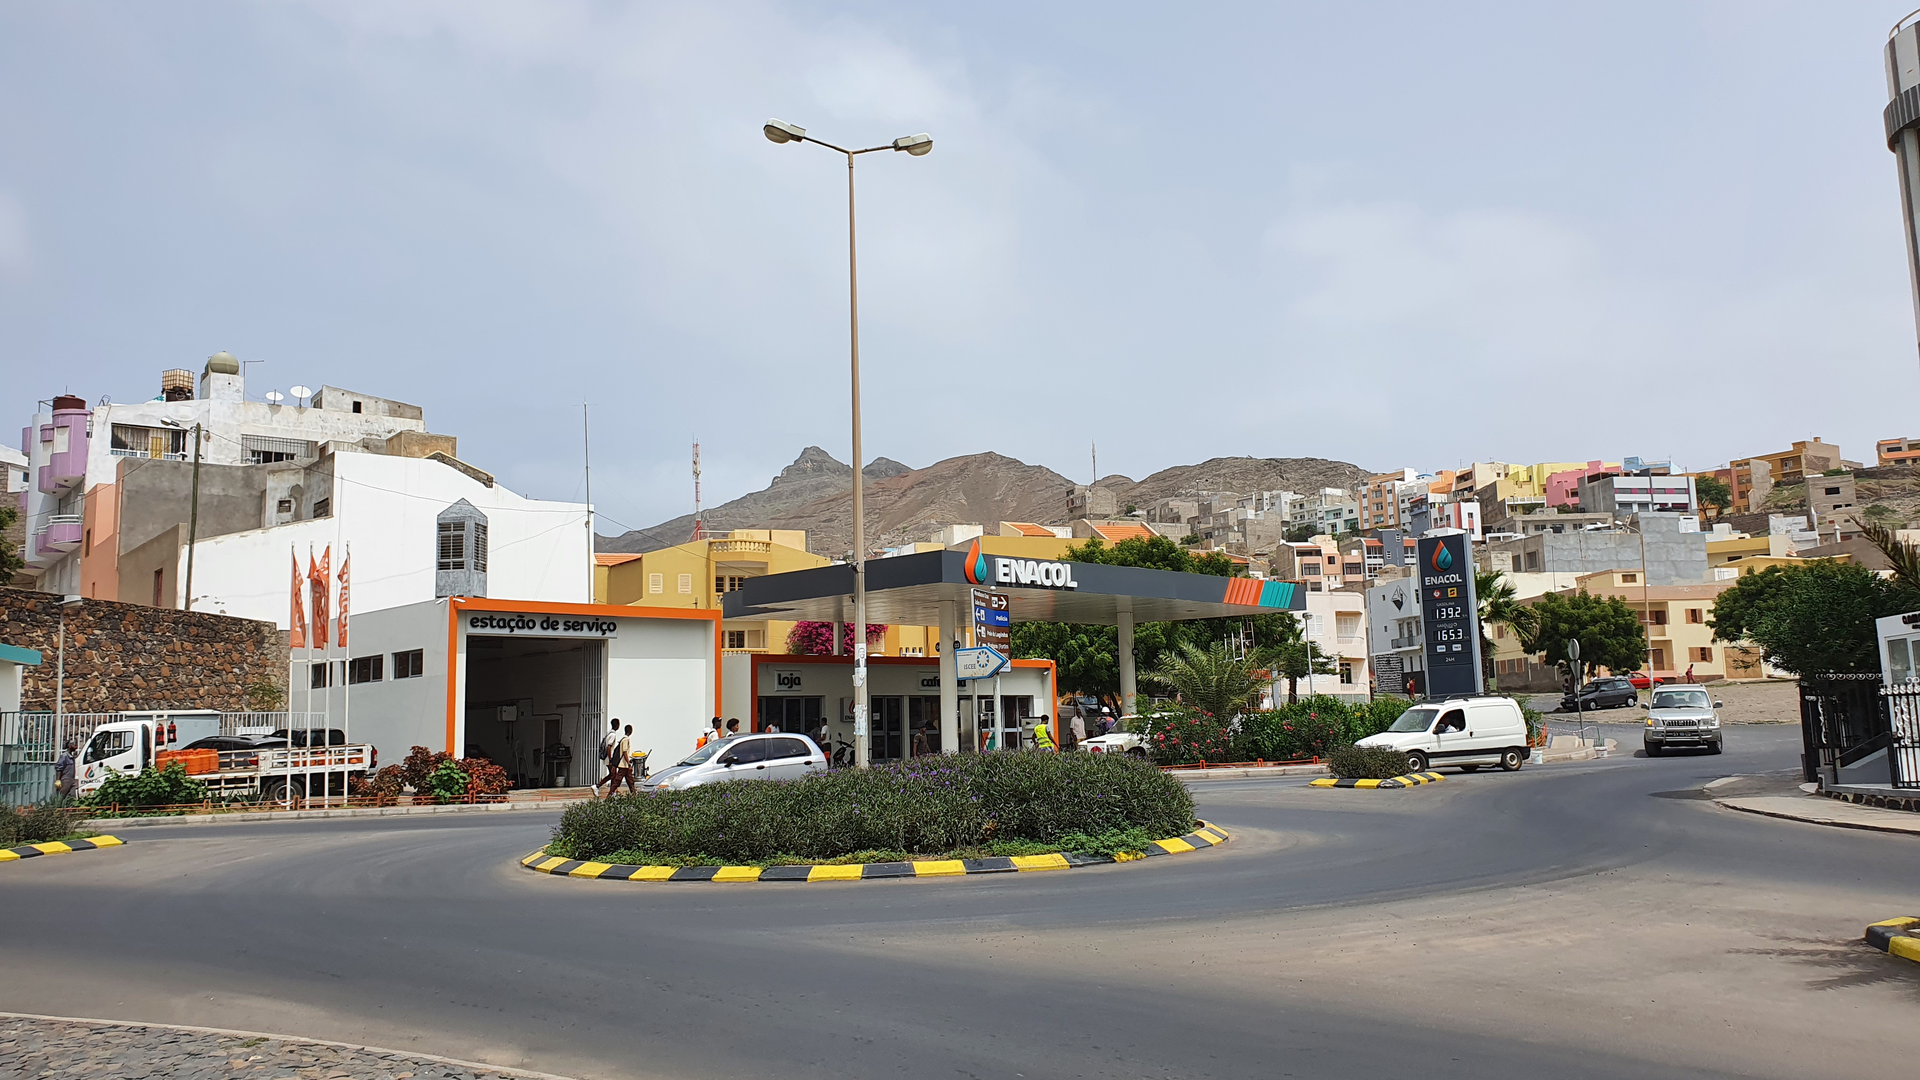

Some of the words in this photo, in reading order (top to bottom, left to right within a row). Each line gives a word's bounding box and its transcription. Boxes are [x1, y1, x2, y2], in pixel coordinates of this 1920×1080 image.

[994, 558, 1078, 588] ENACOL
[1424, 574, 1463, 585] ENACOL
[1436, 606, 1461, 619] 139.2
[469, 614, 536, 633] estação
[540, 616, 560, 631] de
[563, 618, 617, 636] serviço
[1437, 628, 1463, 641] 165.3
[777, 673, 802, 689] loja
